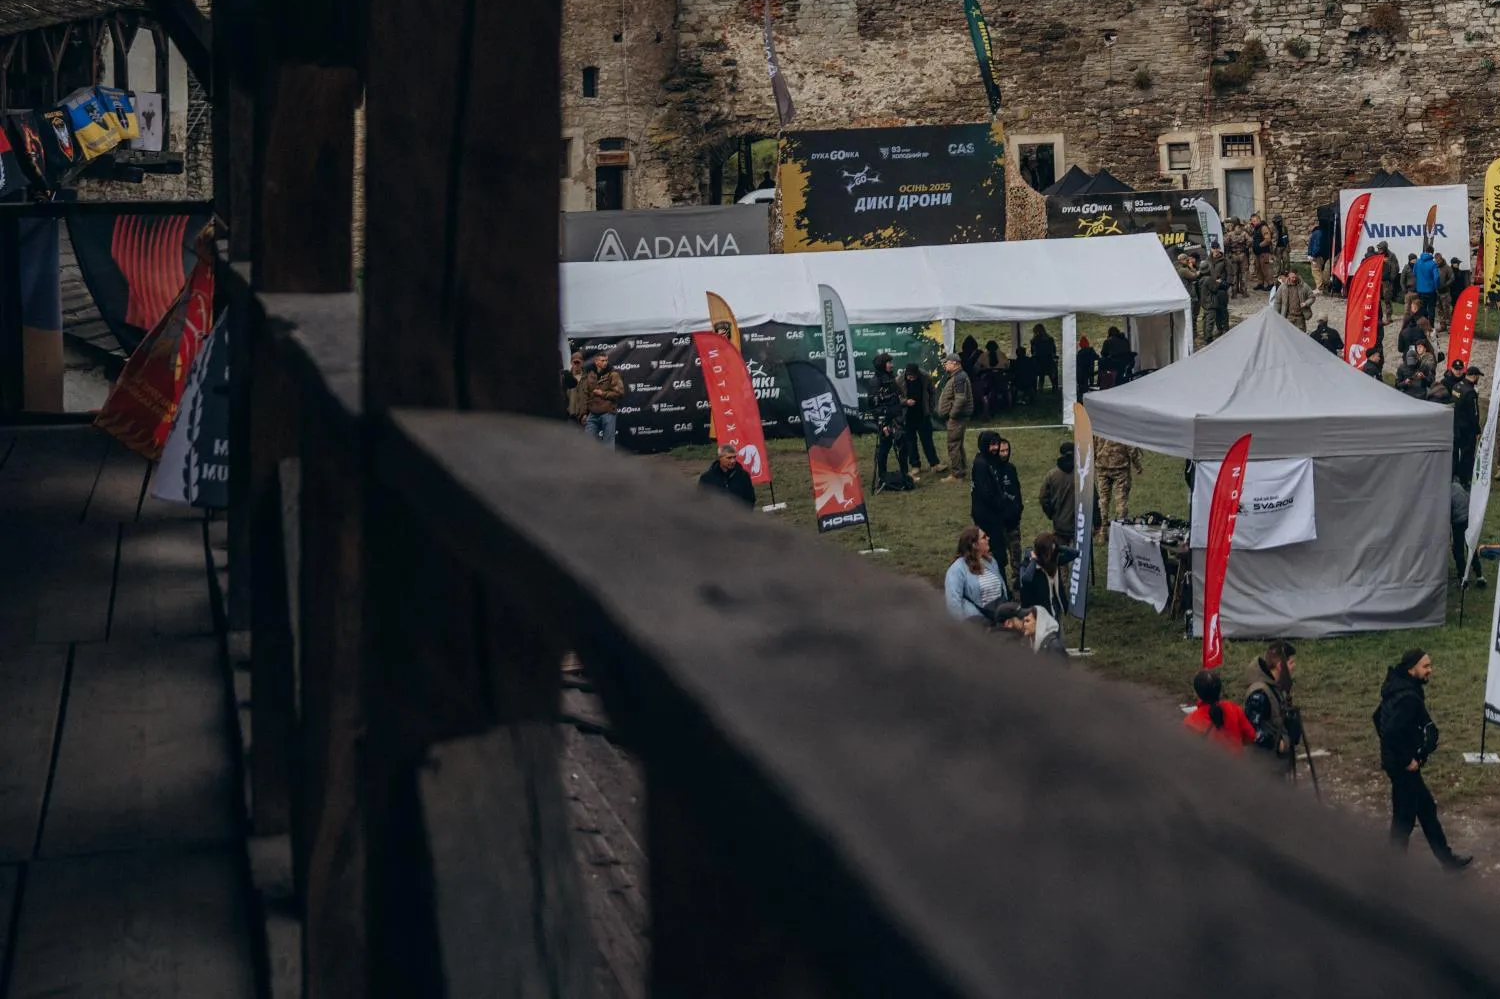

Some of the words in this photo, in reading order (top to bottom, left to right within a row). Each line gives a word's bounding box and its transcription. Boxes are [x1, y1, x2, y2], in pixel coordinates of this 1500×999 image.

[948, 142, 975, 154] CAS
[899, 183, 928, 193] ОСІНЬ
[929, 182, 951, 192] 2025
[854, 195, 894, 213] ДИКІ
[897, 192, 953, 211] ДРОНИ
[1092, 225, 1104, 234] GO
[633, 232, 740, 260] ADAMA
[1362, 270, 1376, 344] SKYETON
[786, 330, 805, 339] CAS
[895, 326, 914, 335] CAS
[672, 337, 691, 345] CAS
[672, 379, 692, 389] CAS
[696, 400, 712, 409] CA
[674, 422, 693, 432] CAS
